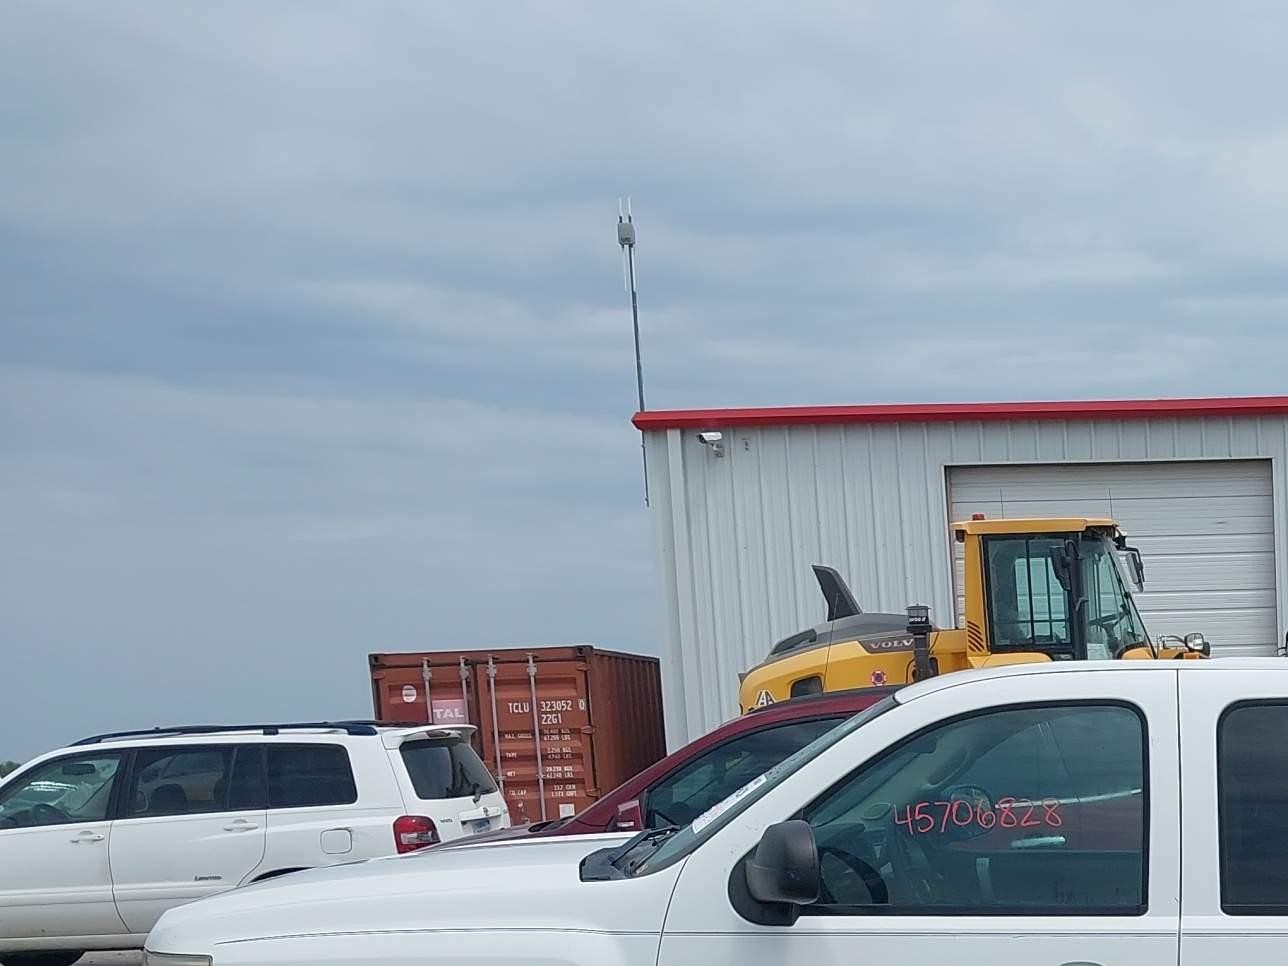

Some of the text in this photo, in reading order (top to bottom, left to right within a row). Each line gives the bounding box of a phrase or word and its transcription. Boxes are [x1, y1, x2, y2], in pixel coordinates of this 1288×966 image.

[870, 638, 914, 649] VOLV
[507, 702, 530, 713] TCLU
[540, 700, 573, 712] 323052
[432, 708, 465, 719] TAL
[541, 713, 562, 725] 22G1
[893, 796, 1062, 835] 45706828
